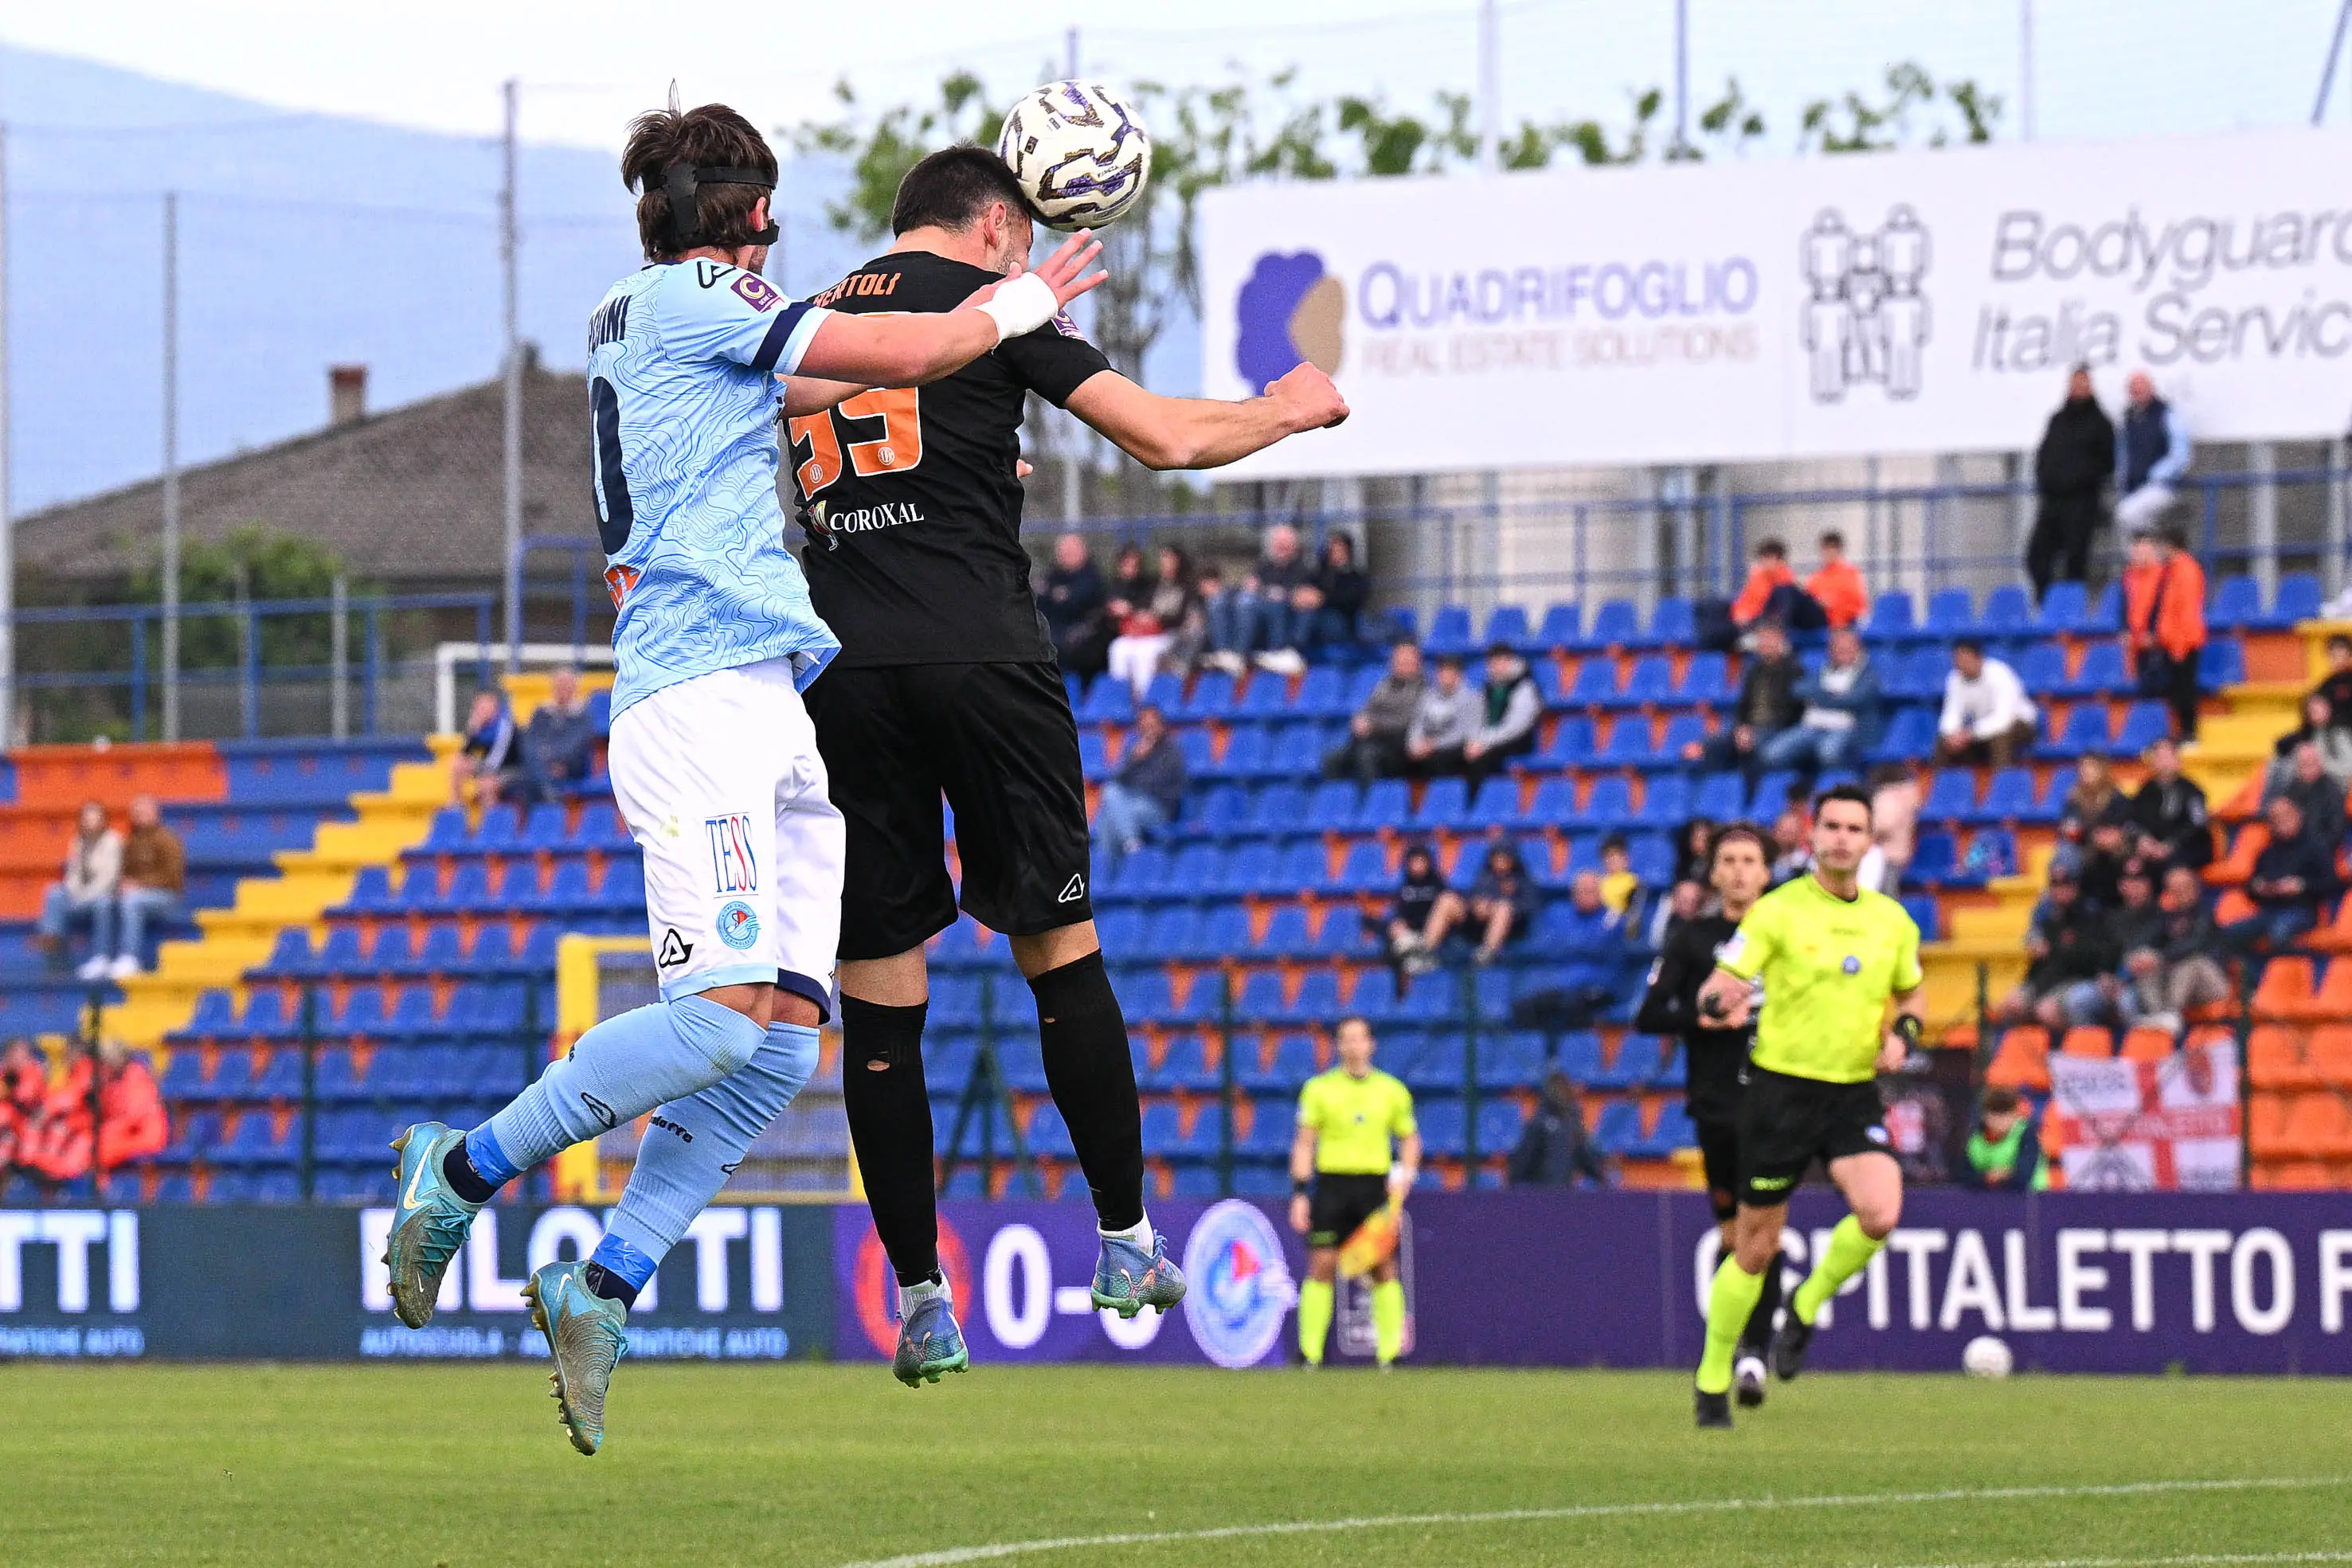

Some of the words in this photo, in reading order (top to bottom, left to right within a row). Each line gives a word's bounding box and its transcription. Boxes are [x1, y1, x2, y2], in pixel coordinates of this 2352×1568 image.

[1359, 256, 1759, 330] QUADRIFOGLIO
[1972, 300, 2121, 372] Italia
[830, 502, 925, 534] COROXAL
[706, 815, 757, 893] TESS
